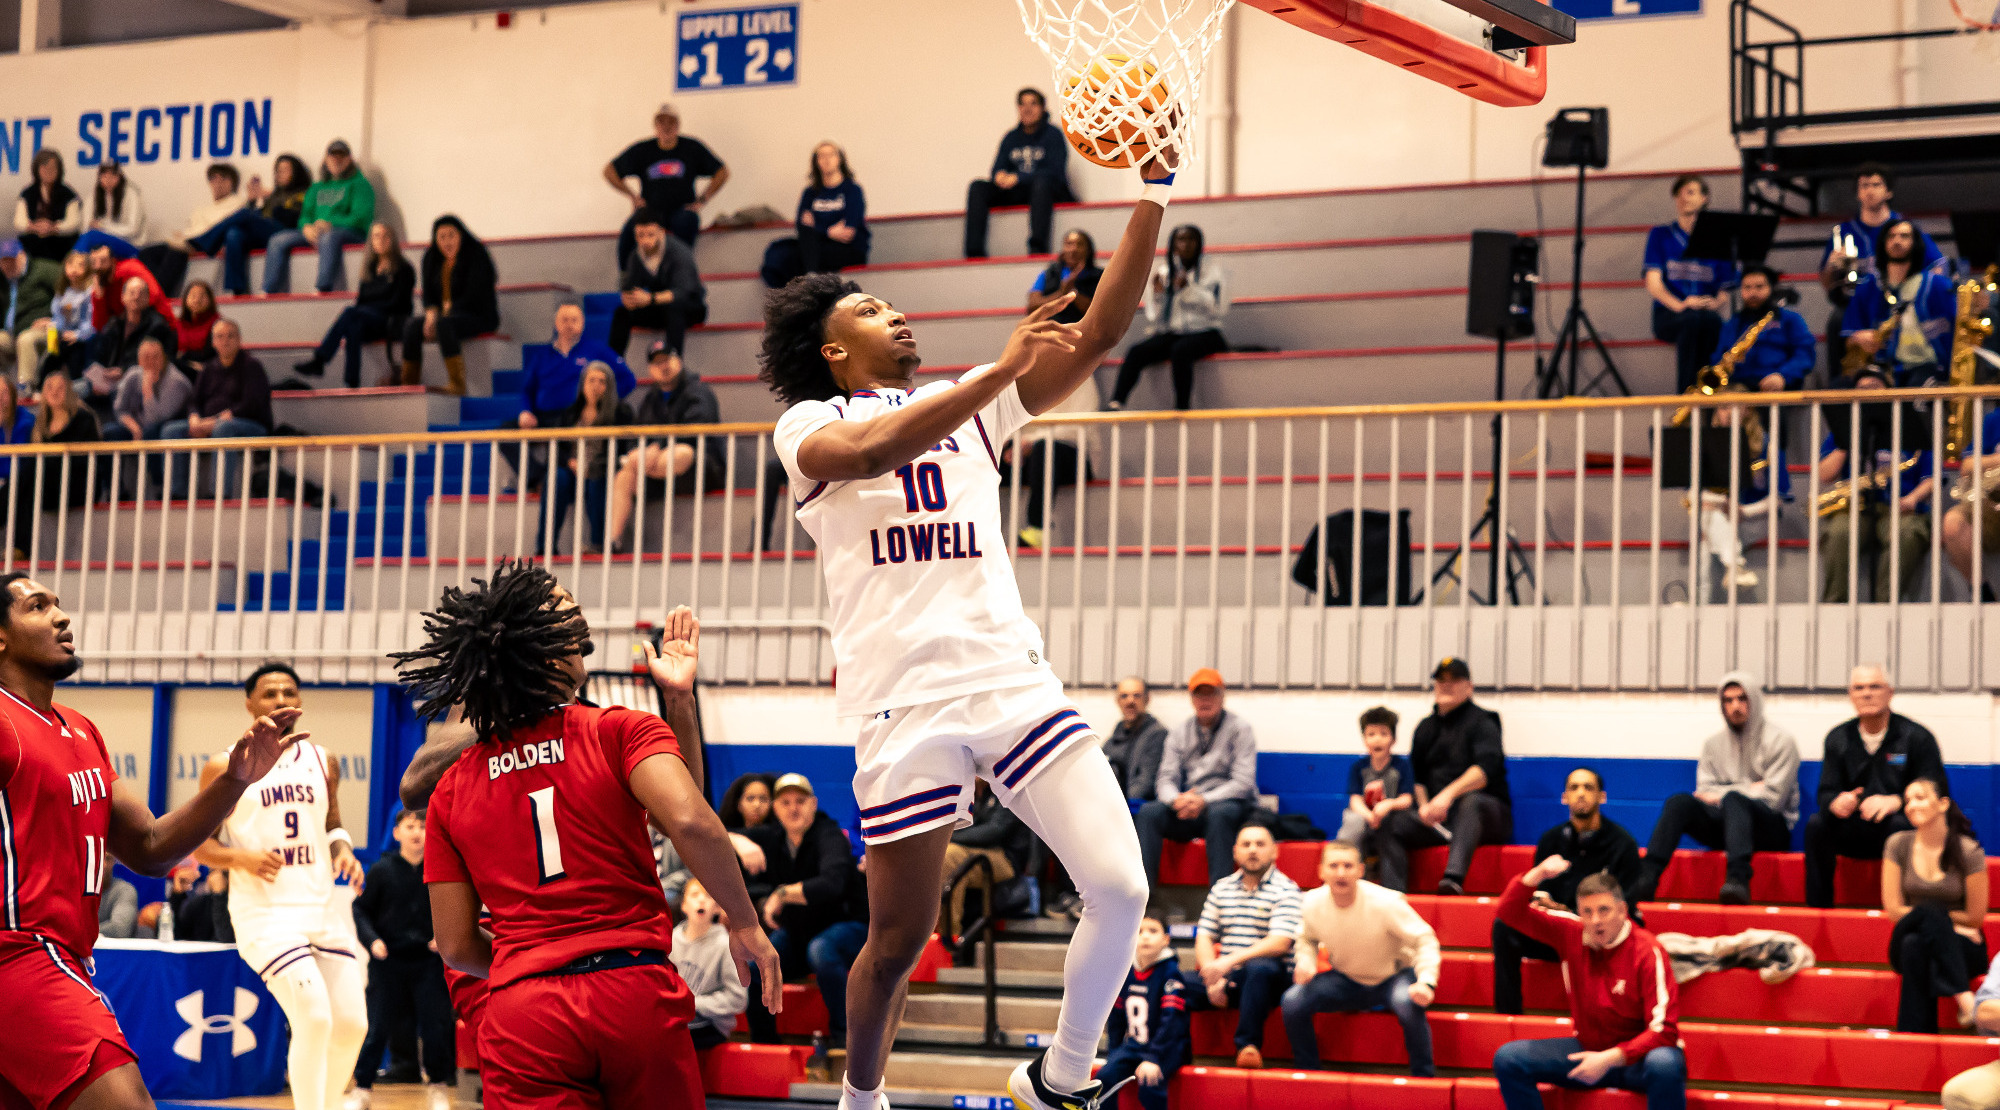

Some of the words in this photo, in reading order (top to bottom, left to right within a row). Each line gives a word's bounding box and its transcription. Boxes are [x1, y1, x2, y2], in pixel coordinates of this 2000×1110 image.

[681, 14, 738, 40] UPPER
[742, 10, 793, 36] LEVEL
[700, 41, 722, 85] 1
[744, 38, 769, 83] 2
[77, 97, 272, 168] SECTION
[895, 461, 948, 513] 10
[869, 520, 983, 566] LOWELL
[488, 738, 566, 781] BOLDEN
[67, 767, 107, 814] NJIT
[260, 784, 315, 809] UMASS
[284, 811, 299, 839] 9
[527, 785, 568, 887] 1
[1125, 995, 1149, 1045] 8
